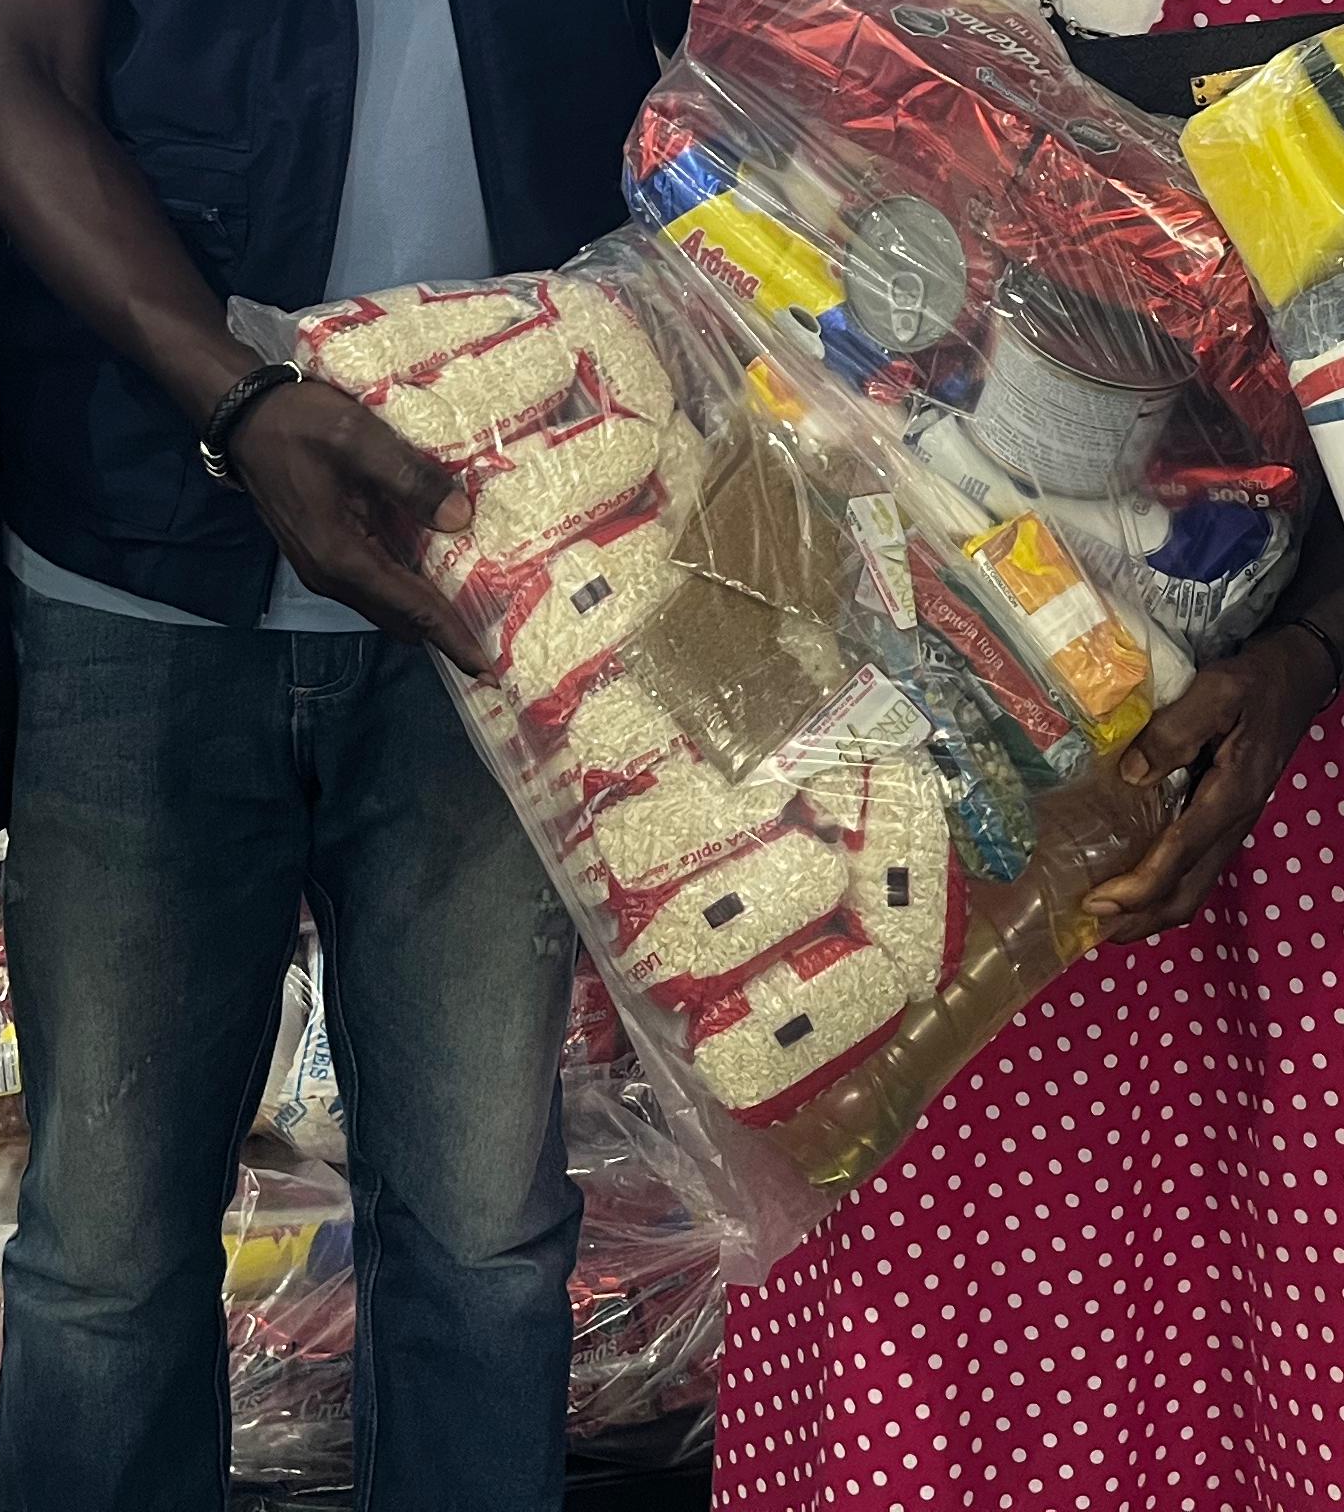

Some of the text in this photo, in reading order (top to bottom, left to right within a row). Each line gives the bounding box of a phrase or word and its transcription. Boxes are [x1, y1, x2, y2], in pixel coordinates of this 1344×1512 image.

[1208, 487, 1250, 503] 500
[542, 514, 583, 542] opita
[976, 637, 1005, 671] Roja
[679, 841, 723, 866] opita
